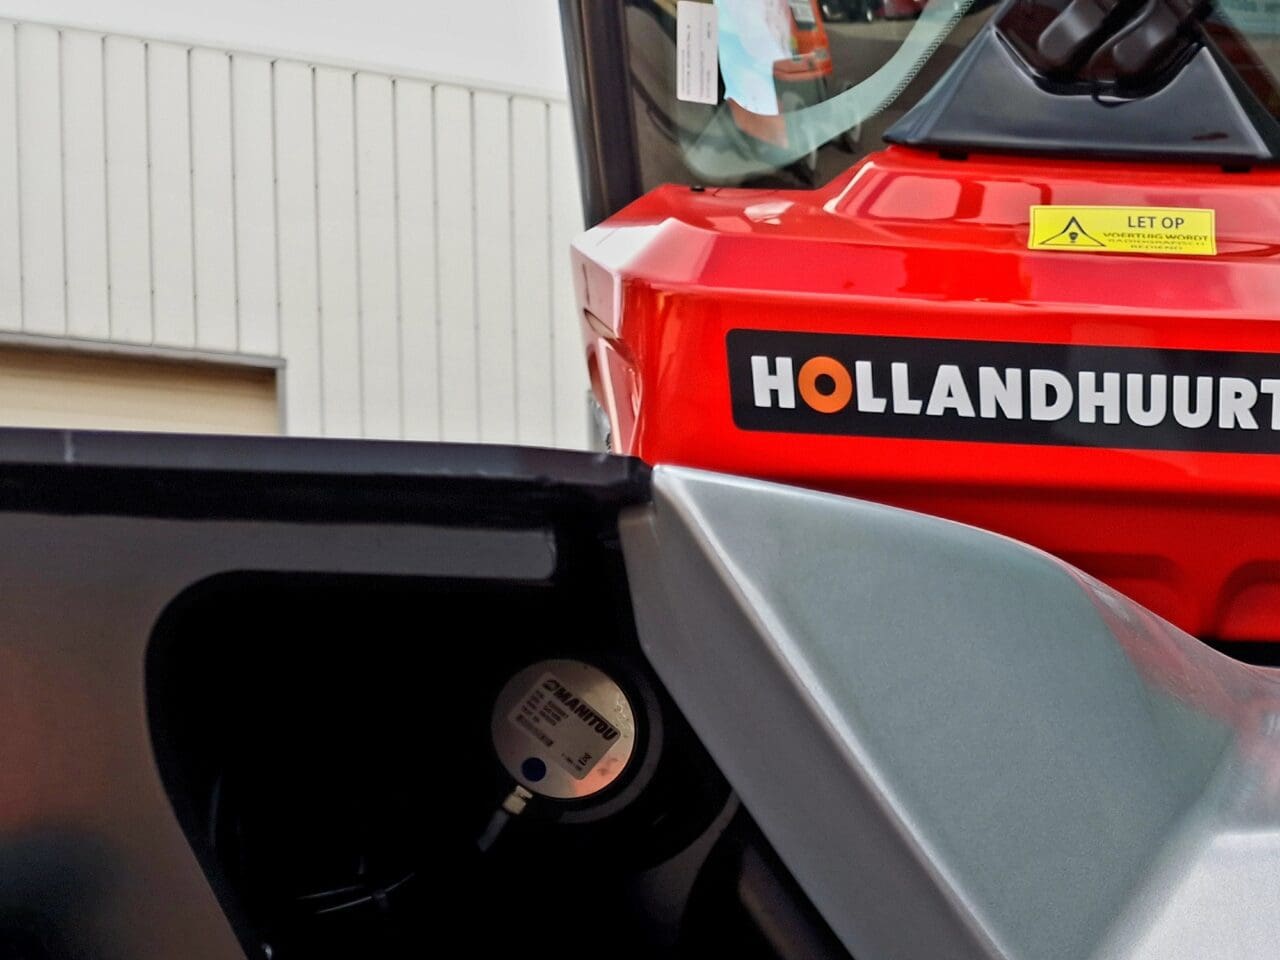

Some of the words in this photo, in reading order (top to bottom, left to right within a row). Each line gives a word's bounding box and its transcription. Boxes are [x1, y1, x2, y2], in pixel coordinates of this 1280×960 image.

[1128, 216, 1156, 228] LET
[1161, 217, 1184, 229] OP
[1165, 234, 1208, 242] WORDT
[553, 688, 618, 741] MANITOU
